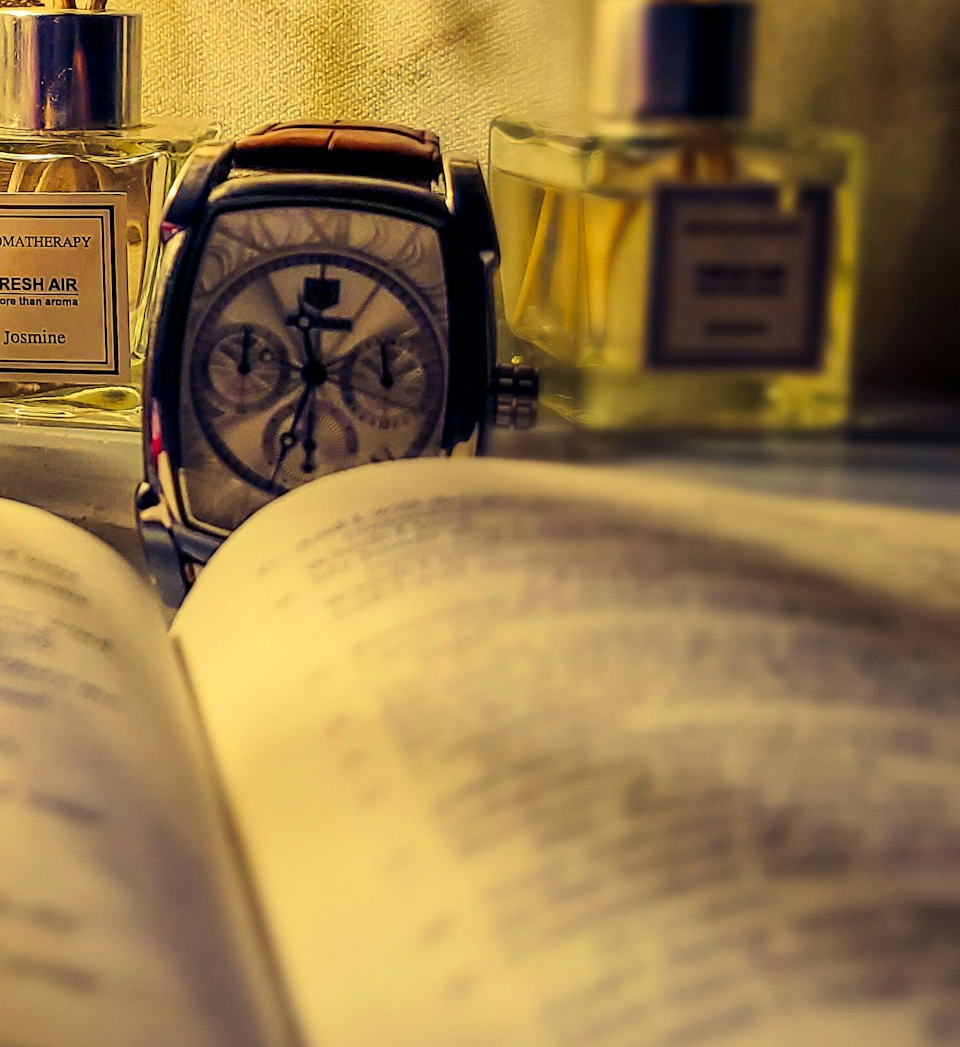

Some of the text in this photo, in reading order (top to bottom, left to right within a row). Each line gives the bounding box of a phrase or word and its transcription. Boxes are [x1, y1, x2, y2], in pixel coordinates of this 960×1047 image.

[48, 277, 78, 292] AIR
[19, 296, 42, 306] than
[45, 297, 78, 307] aroma
[3, 329, 66, 345] Josmine
